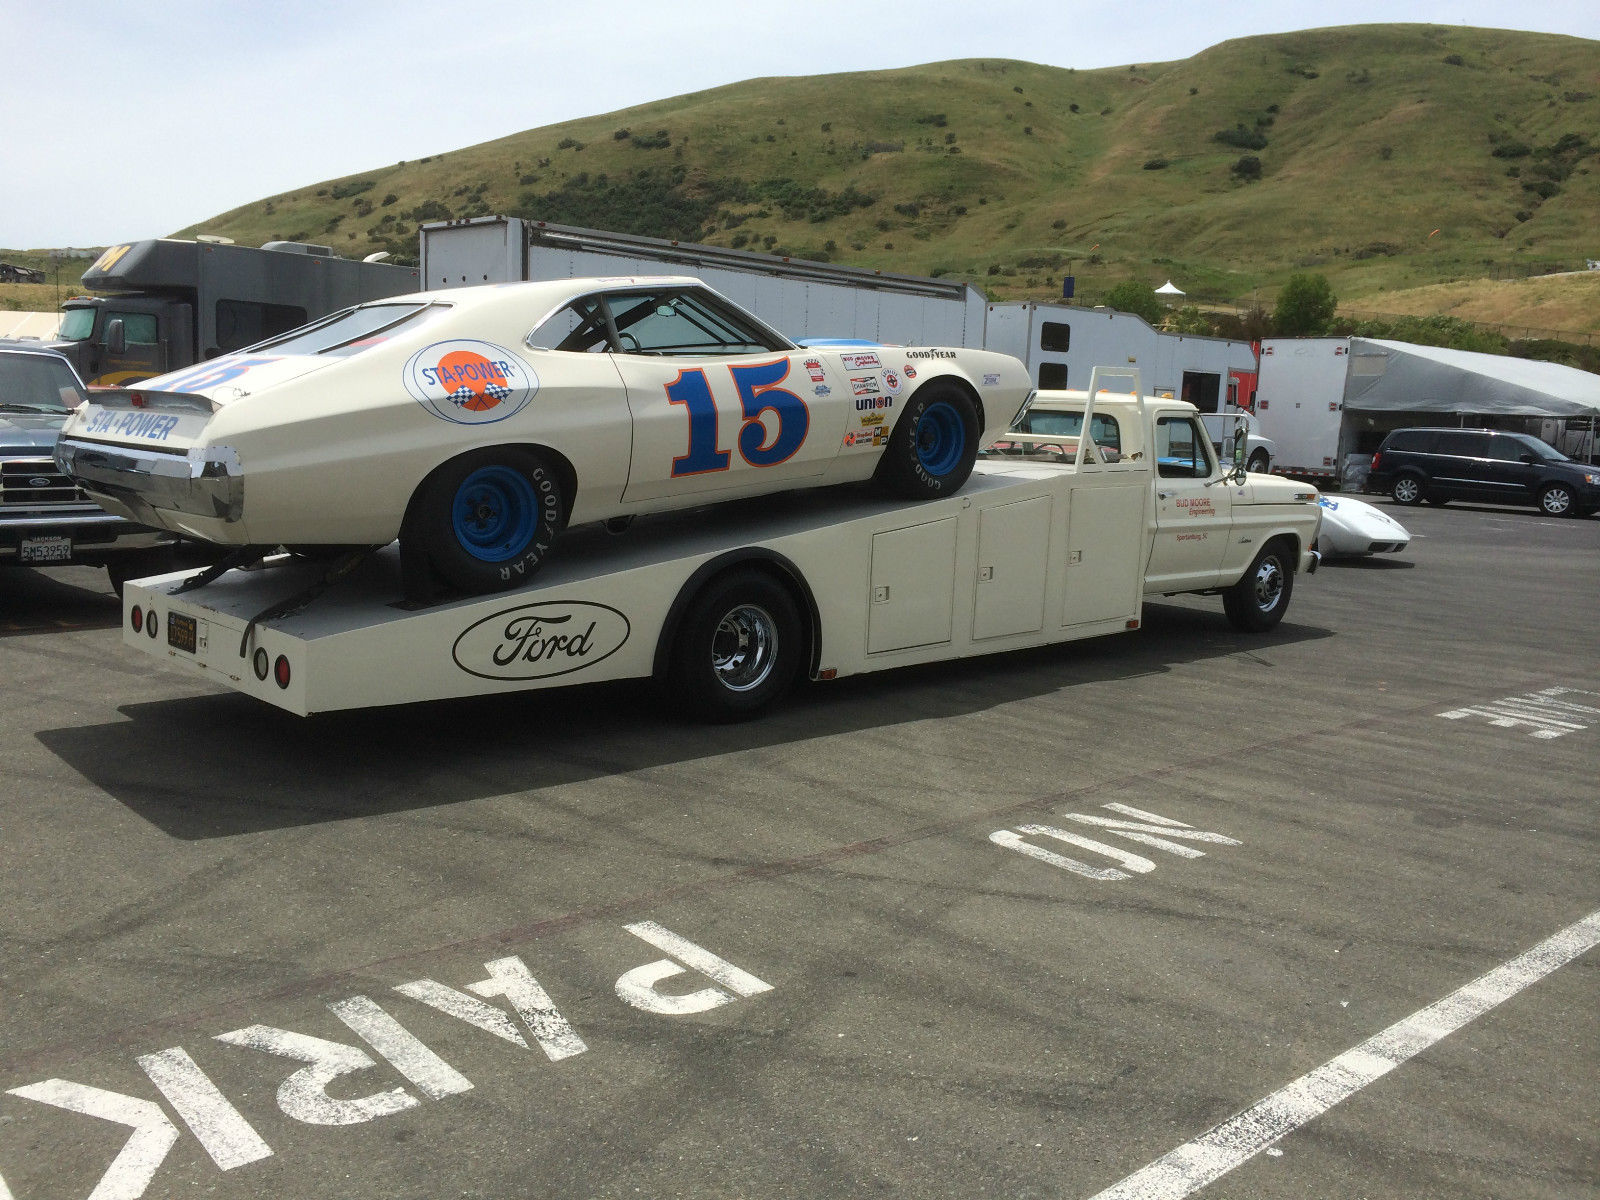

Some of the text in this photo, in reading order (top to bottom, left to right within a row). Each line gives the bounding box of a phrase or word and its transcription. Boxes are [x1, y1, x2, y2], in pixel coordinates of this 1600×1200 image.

[906, 349, 957, 360] GOODYEAR
[664, 356, 810, 478] 15
[500, 467, 557, 580] GOODYEAR
[1176, 498, 1211, 508] BUD MOORE
[1189, 508, 1216, 517] Engineering
[493, 614, 597, 666] Ford
[0, 921, 775, 1200] PARK
